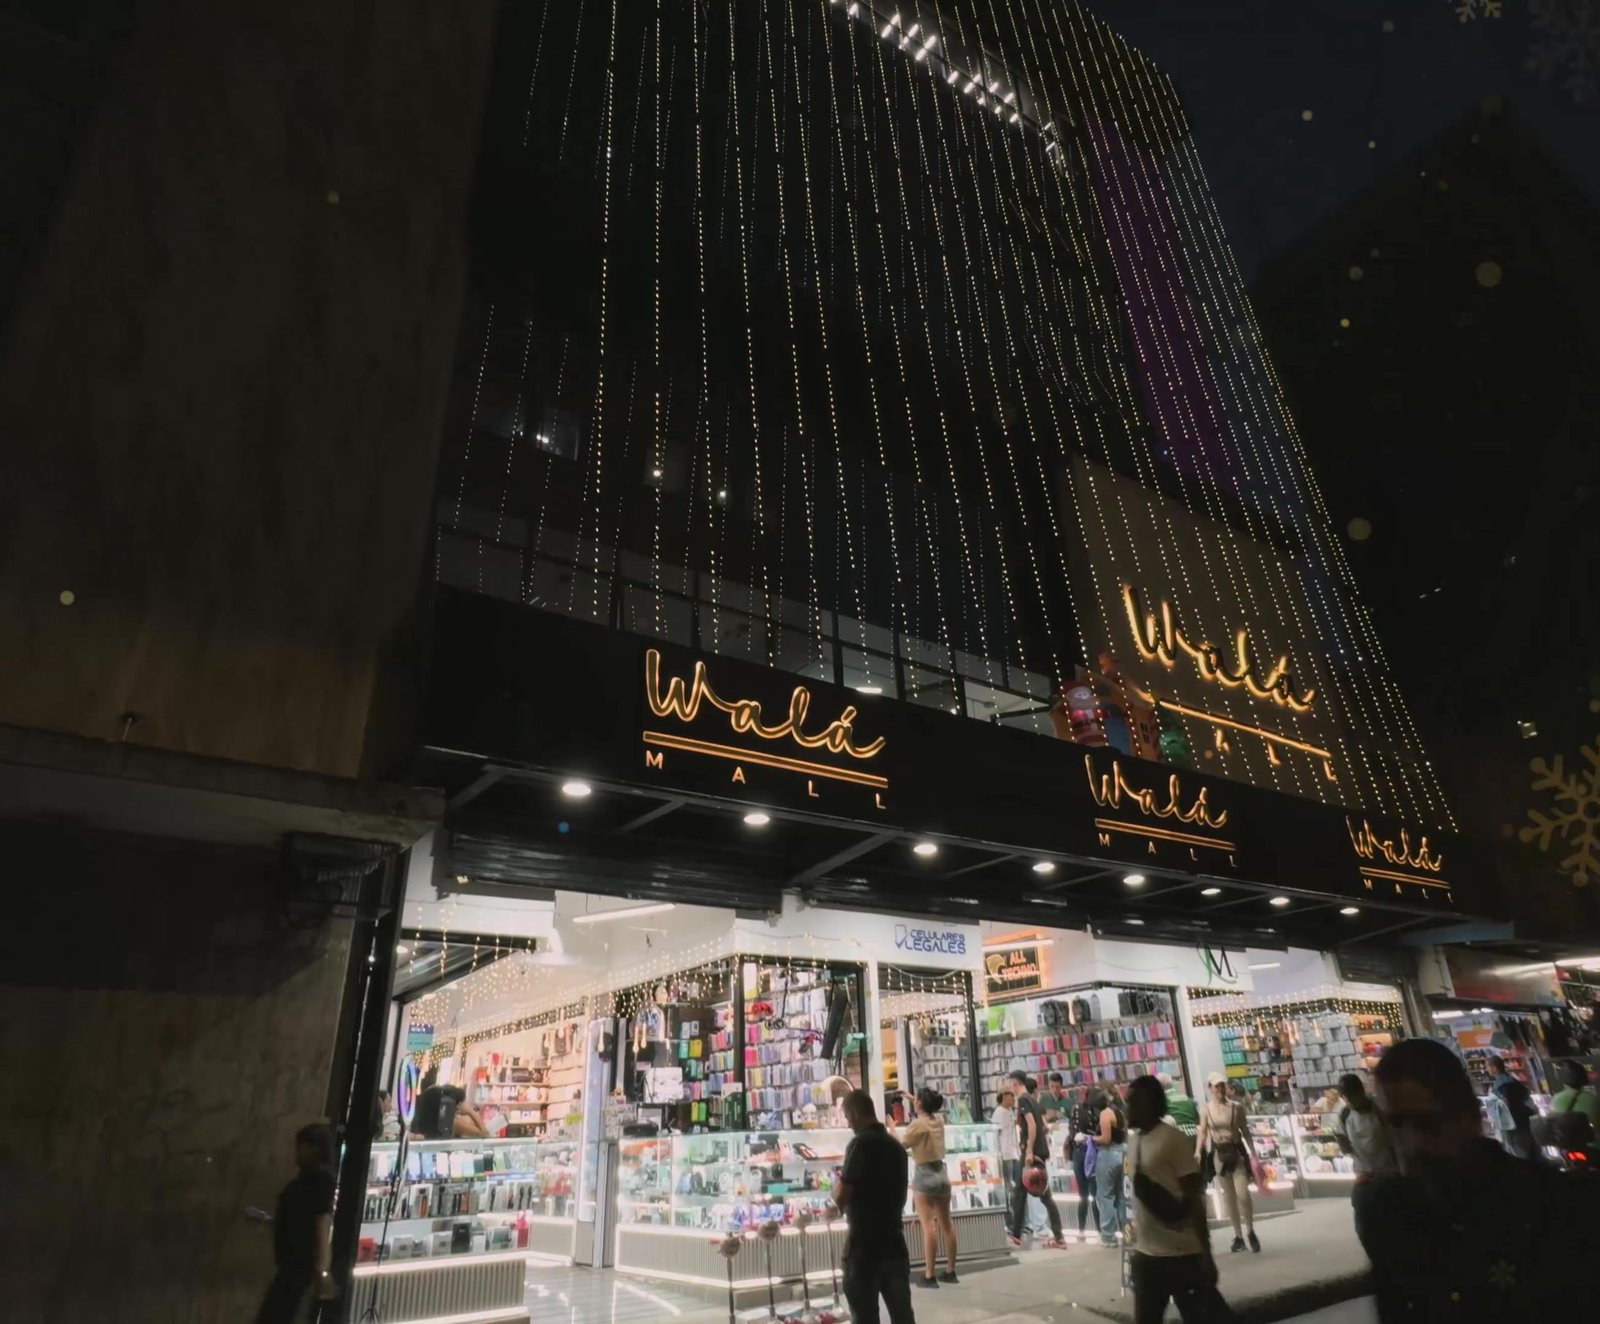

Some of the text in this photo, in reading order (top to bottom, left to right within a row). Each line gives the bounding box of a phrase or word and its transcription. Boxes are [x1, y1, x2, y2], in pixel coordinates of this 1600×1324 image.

[645, 647, 887, 760] Walá
[645, 749, 887, 810] MALL
[1084, 753, 1228, 830] Walá
[1097, 832, 1239, 868] MALL
[1345, 815, 1443, 873] Walá
[1363, 878, 1454, 904] MALL
[905, 938, 967, 955] LEGALES
[910, 929, 966, 943] CELULARES
[1009, 949, 1027, 965] ALL
